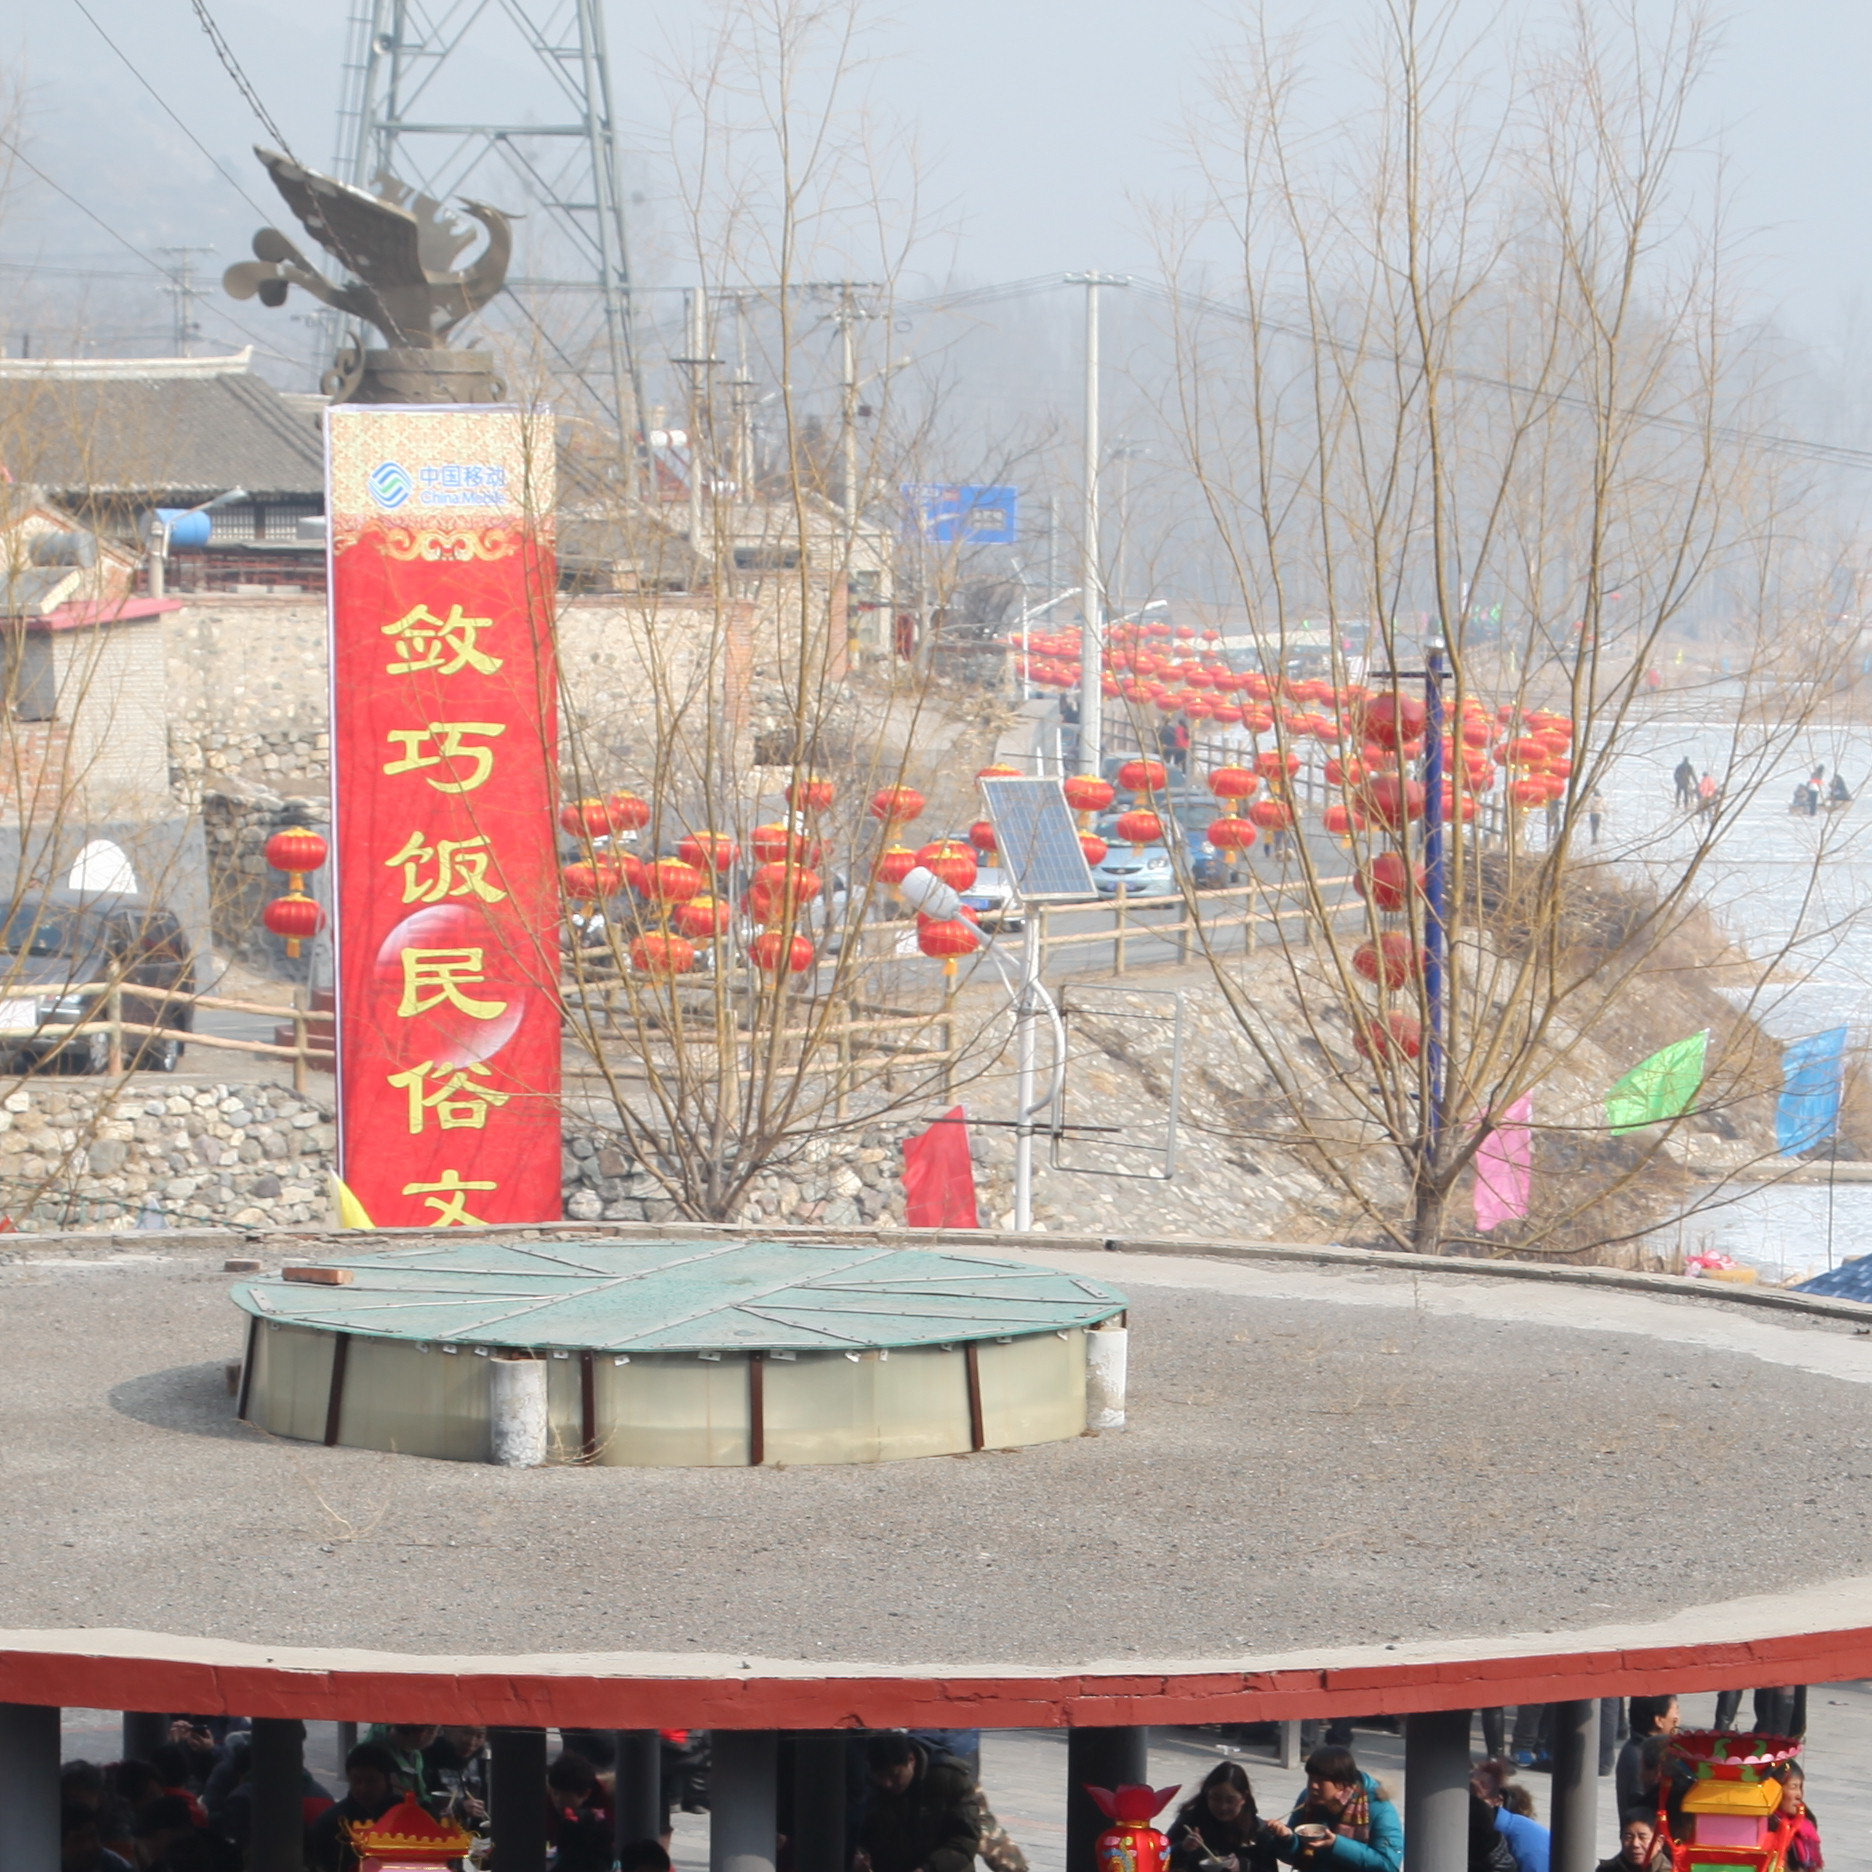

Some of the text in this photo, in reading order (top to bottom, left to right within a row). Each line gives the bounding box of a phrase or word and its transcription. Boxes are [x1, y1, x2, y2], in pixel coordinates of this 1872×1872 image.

[419, 464, 506, 488] 中国移动
[419, 490, 459, 504] China
